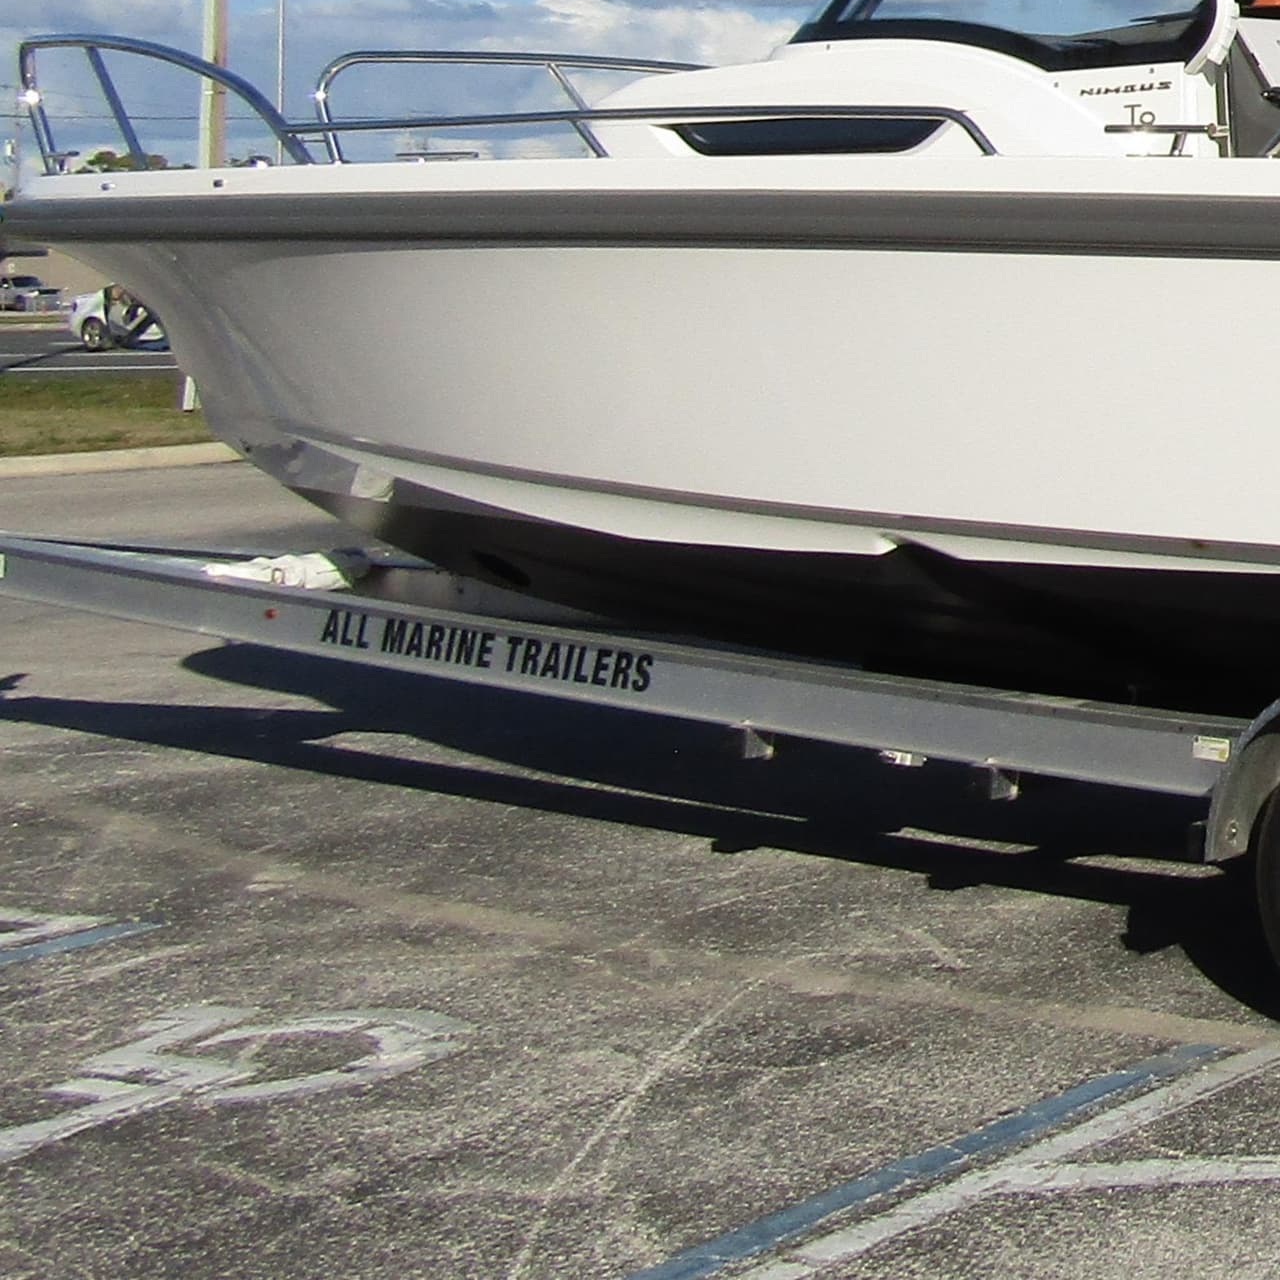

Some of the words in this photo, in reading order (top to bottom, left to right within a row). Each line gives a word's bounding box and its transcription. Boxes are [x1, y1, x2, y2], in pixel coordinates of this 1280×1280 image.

[1080, 81, 1172, 96] NIMBUS
[321, 609, 369, 648] ALL
[380, 617, 496, 669] MARINE
[506, 635, 654, 692] TRAILERS
